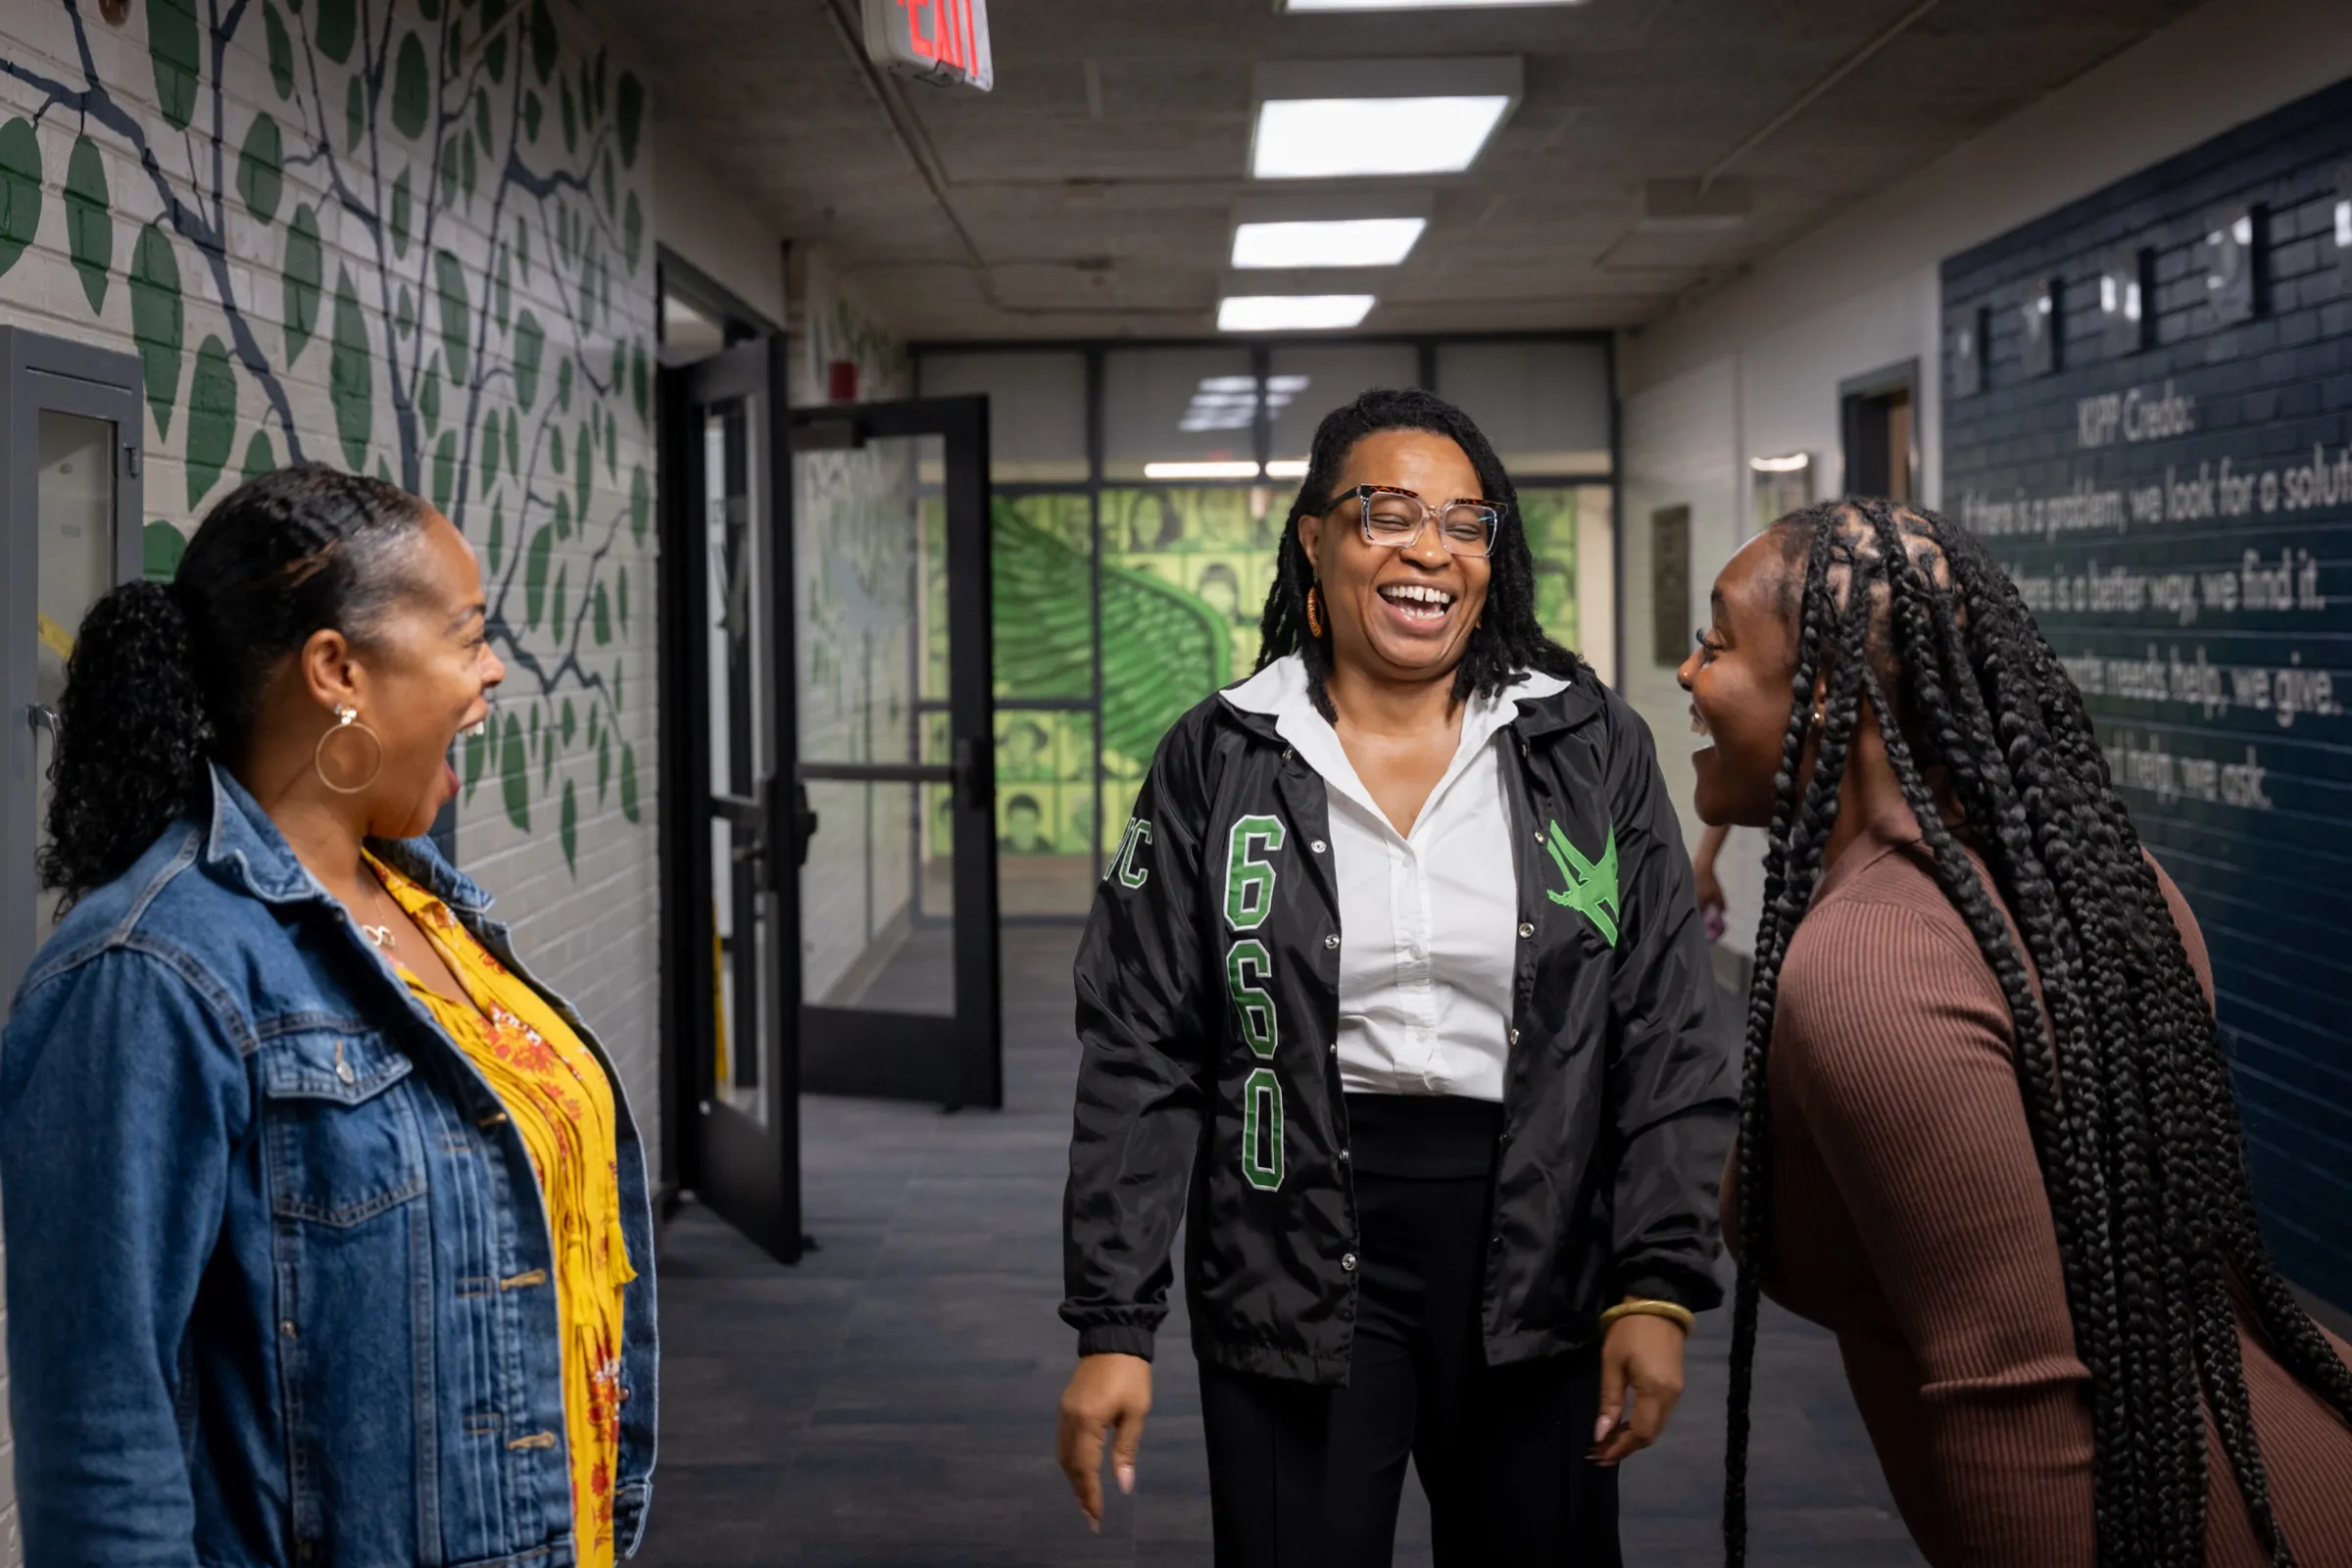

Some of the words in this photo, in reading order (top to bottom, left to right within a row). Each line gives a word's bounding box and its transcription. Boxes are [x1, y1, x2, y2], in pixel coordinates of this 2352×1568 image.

[2016, 487, 2031, 534] is
[2033, 498, 2045, 534] a
[2130, 485, 2162, 524] we
[2166, 464, 2216, 521] look
[2219, 456, 2256, 516] for
[2259, 470, 2280, 514] a
[2055, 562, 2070, 612] is
[2072, 574, 2086, 613] a
[2201, 570, 2239, 611] we
[2242, 547, 2293, 612] find
[2230, 667, 2271, 710] we
[2273, 650, 2343, 728] give.
[2181, 757, 2218, 803] we
